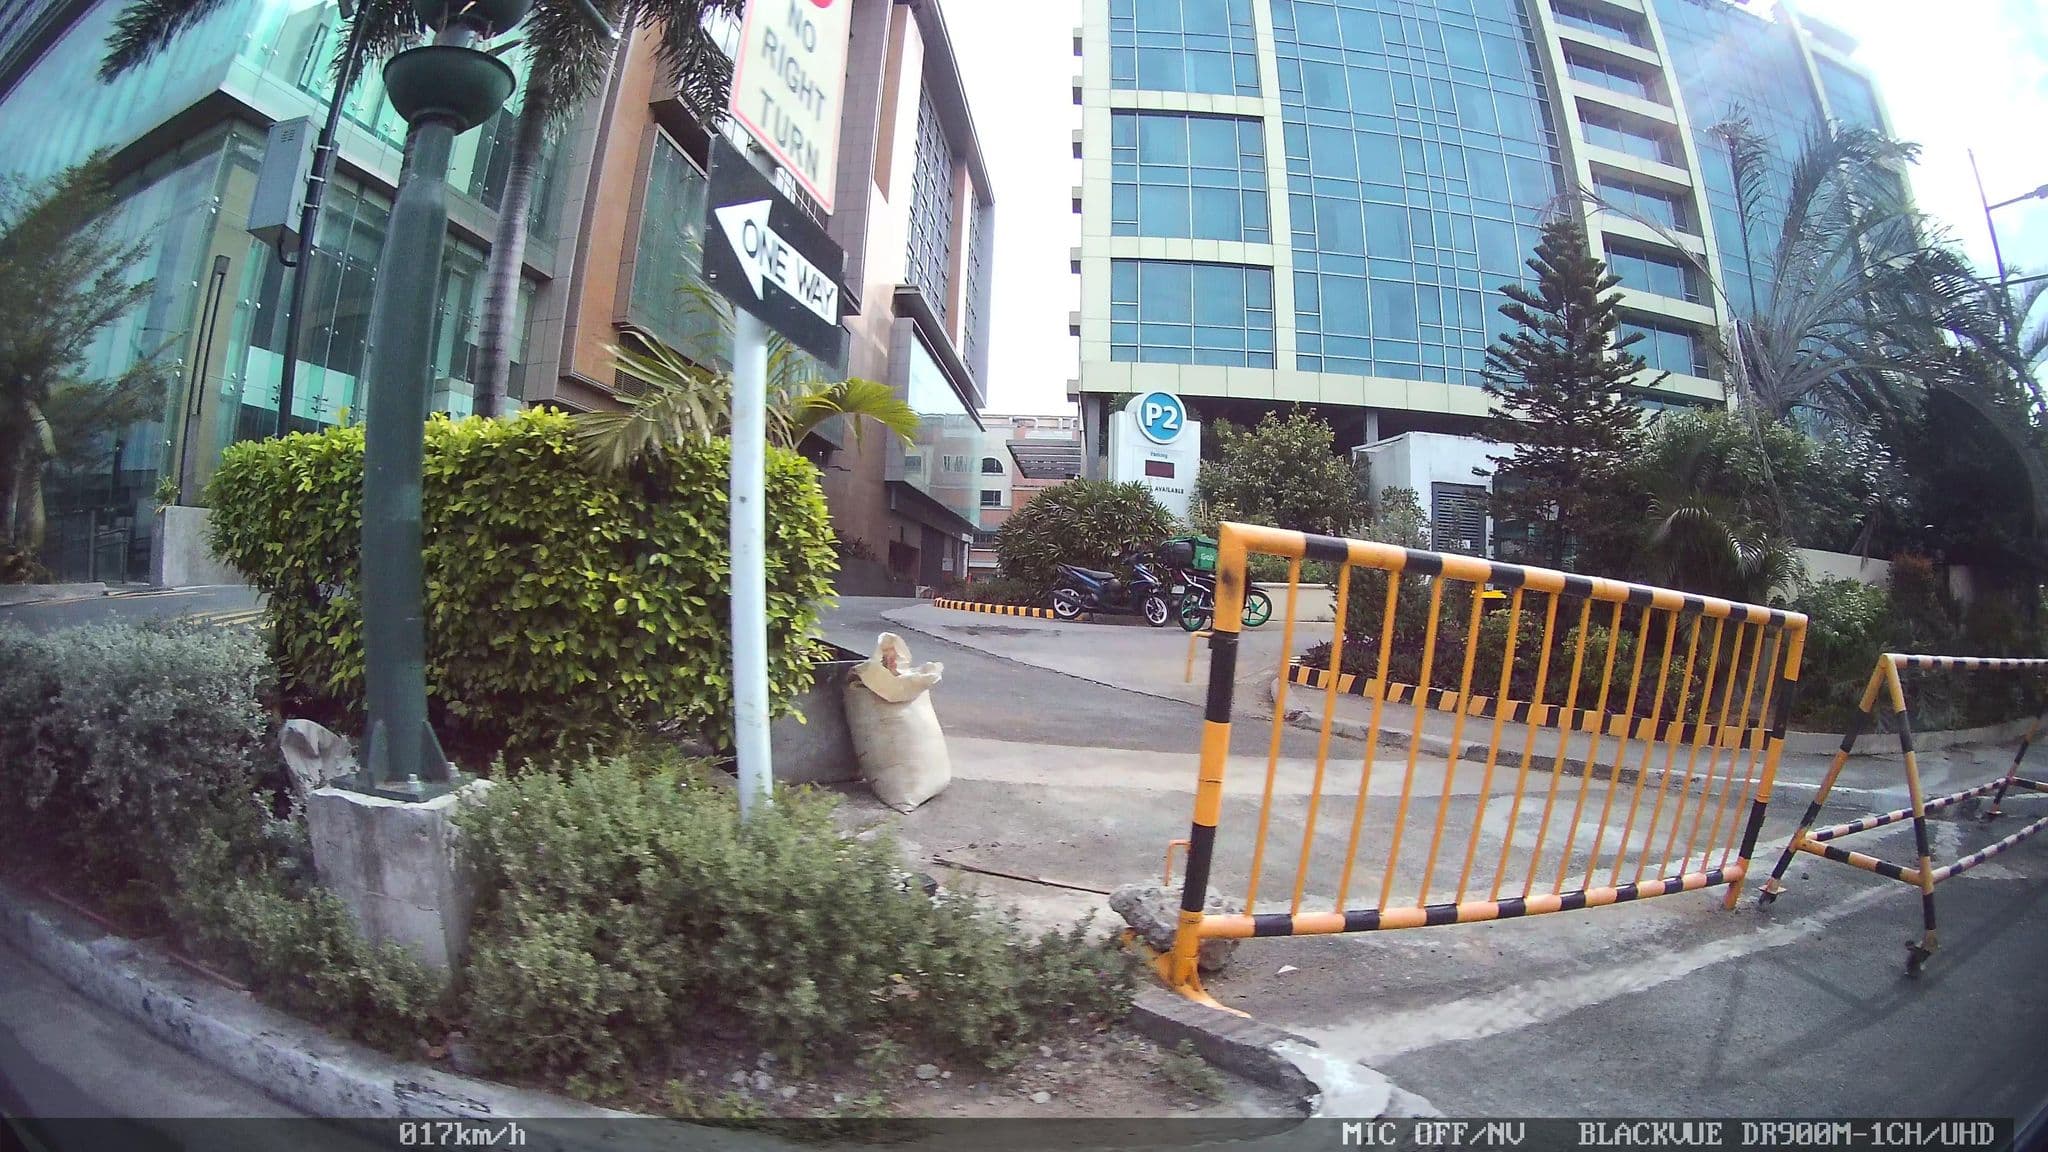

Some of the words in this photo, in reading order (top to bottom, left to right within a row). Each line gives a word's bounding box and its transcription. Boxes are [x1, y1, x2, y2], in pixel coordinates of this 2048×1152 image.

[788, 0, 817, 53] NO
[762, 26, 826, 122] RIGHT
[760, 88, 820, 184] TURN
[742, 218, 787, 285] ONE
[797, 264, 836, 316] WAY
[1145, 402, 1179, 430] P2
[1154, 486, 1185, 495] AVAILABLE
